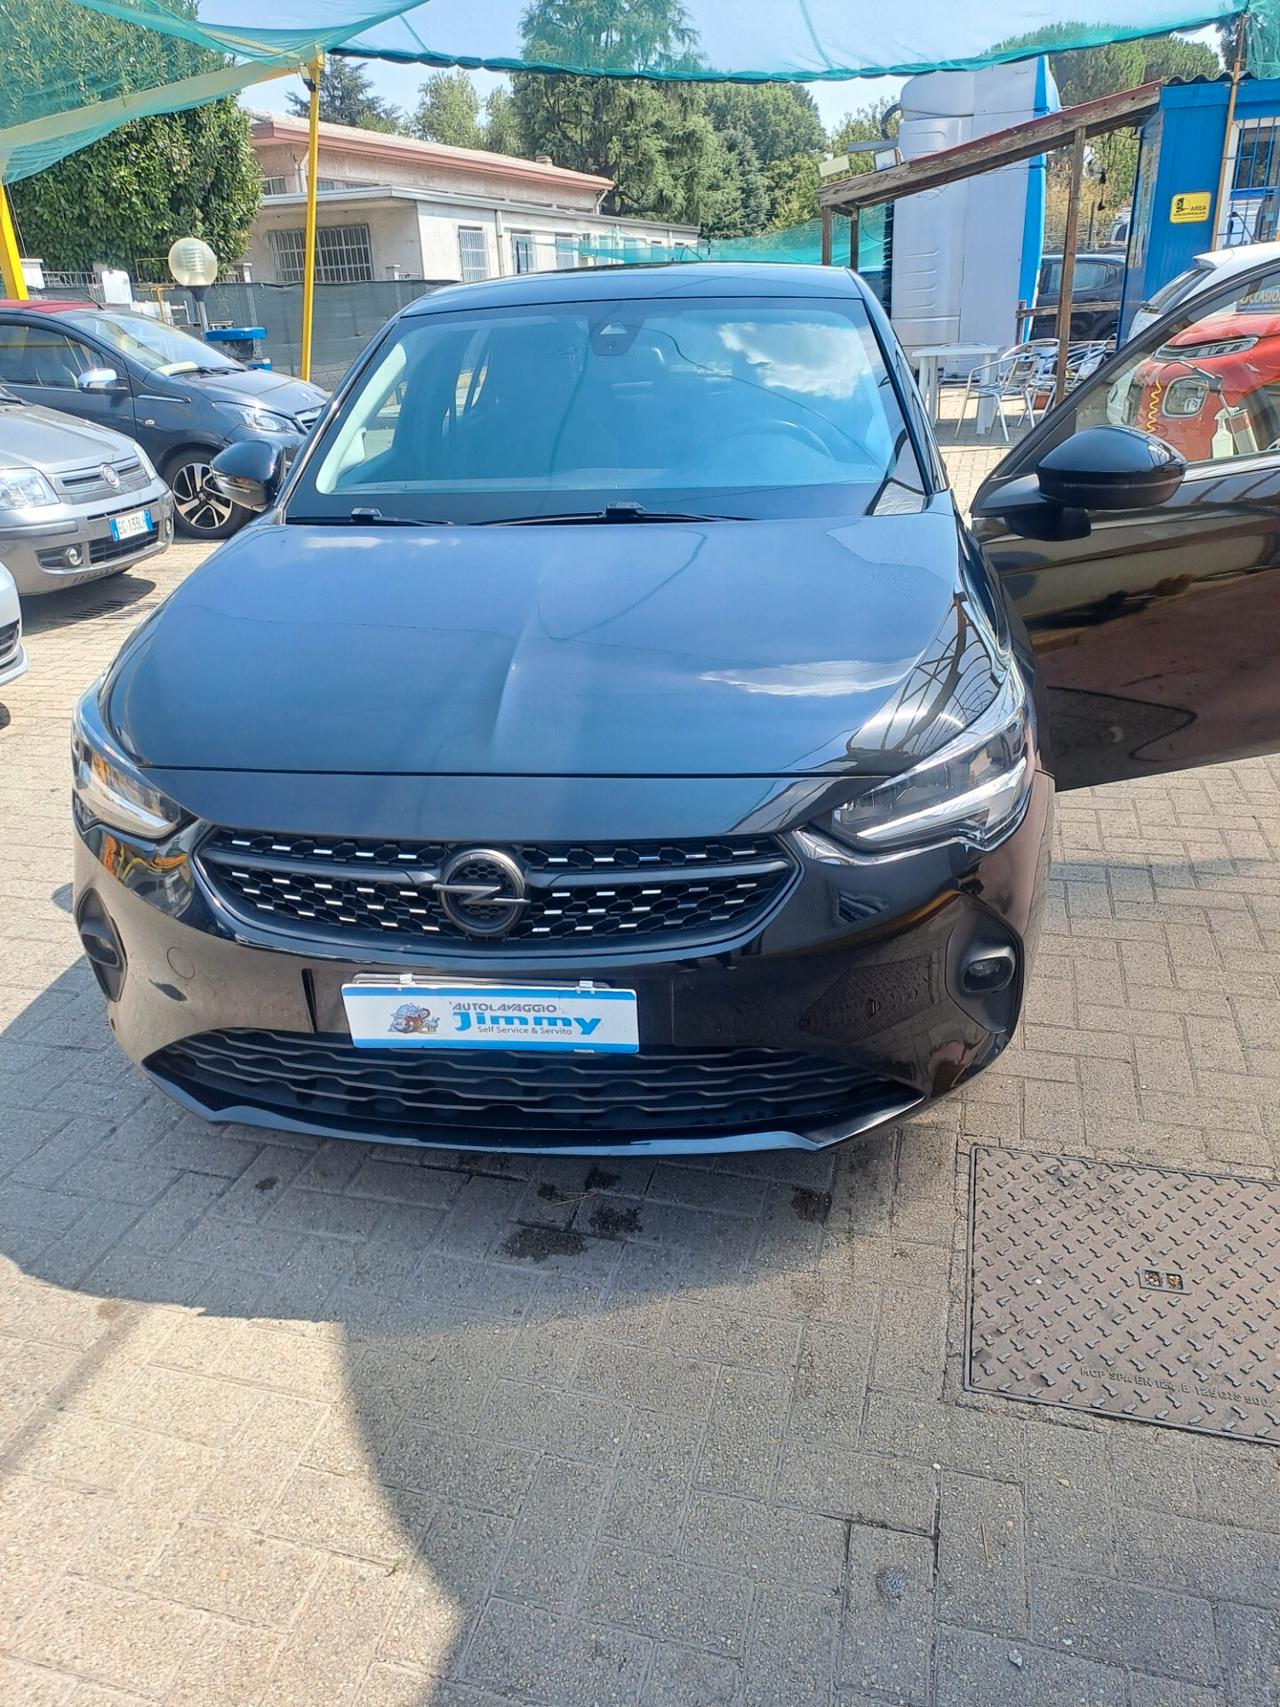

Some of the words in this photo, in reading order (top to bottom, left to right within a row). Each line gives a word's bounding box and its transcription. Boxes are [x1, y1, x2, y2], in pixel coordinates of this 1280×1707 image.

[1239, 289, 1280, 305] OCCASIO
[452, 1002, 558, 1013] AUTOLAVAGGIO
[477, 1026, 494, 1034] Self
[495, 1026, 529, 1035] Service
[531, 1027, 539, 1035] &
[541, 1028, 573, 1036] Servito
[1109, 1372, 1133, 1384] SPA
[1134, 1375, 1153, 1387] EN
